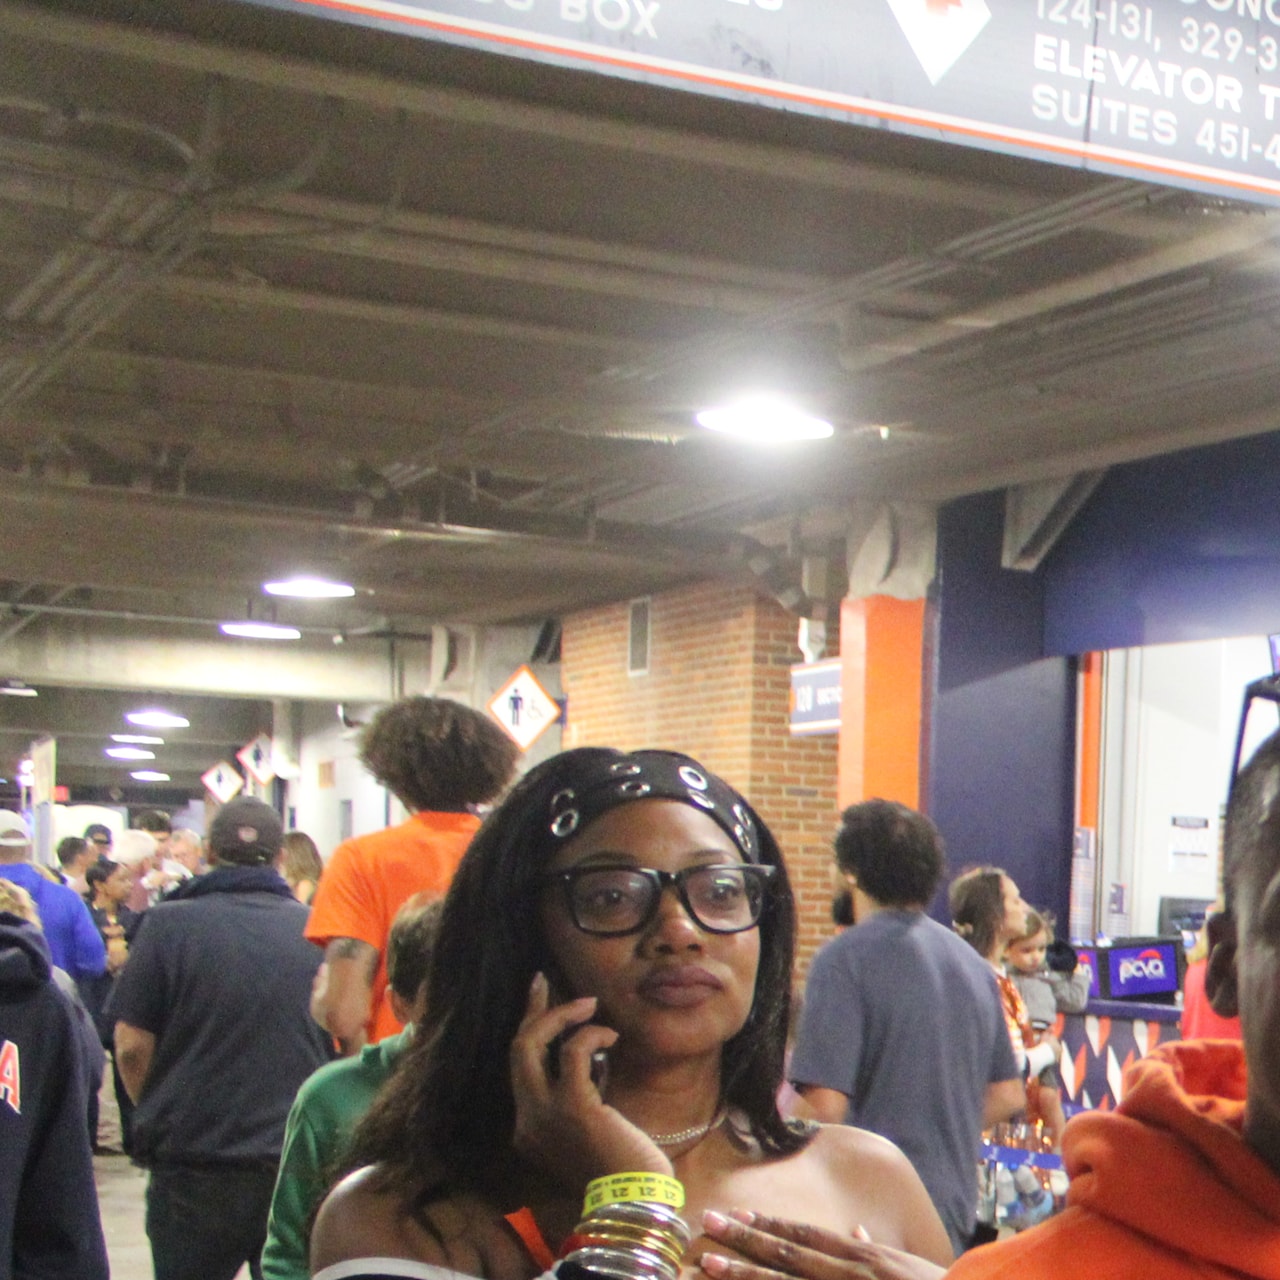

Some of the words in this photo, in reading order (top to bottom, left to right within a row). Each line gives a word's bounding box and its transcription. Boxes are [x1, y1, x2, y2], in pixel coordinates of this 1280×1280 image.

[560, 0, 660, 39] BOX
[1033, 33, 1243, 113] ELEVATOR
[1032, 84, 1177, 146] SUITES
